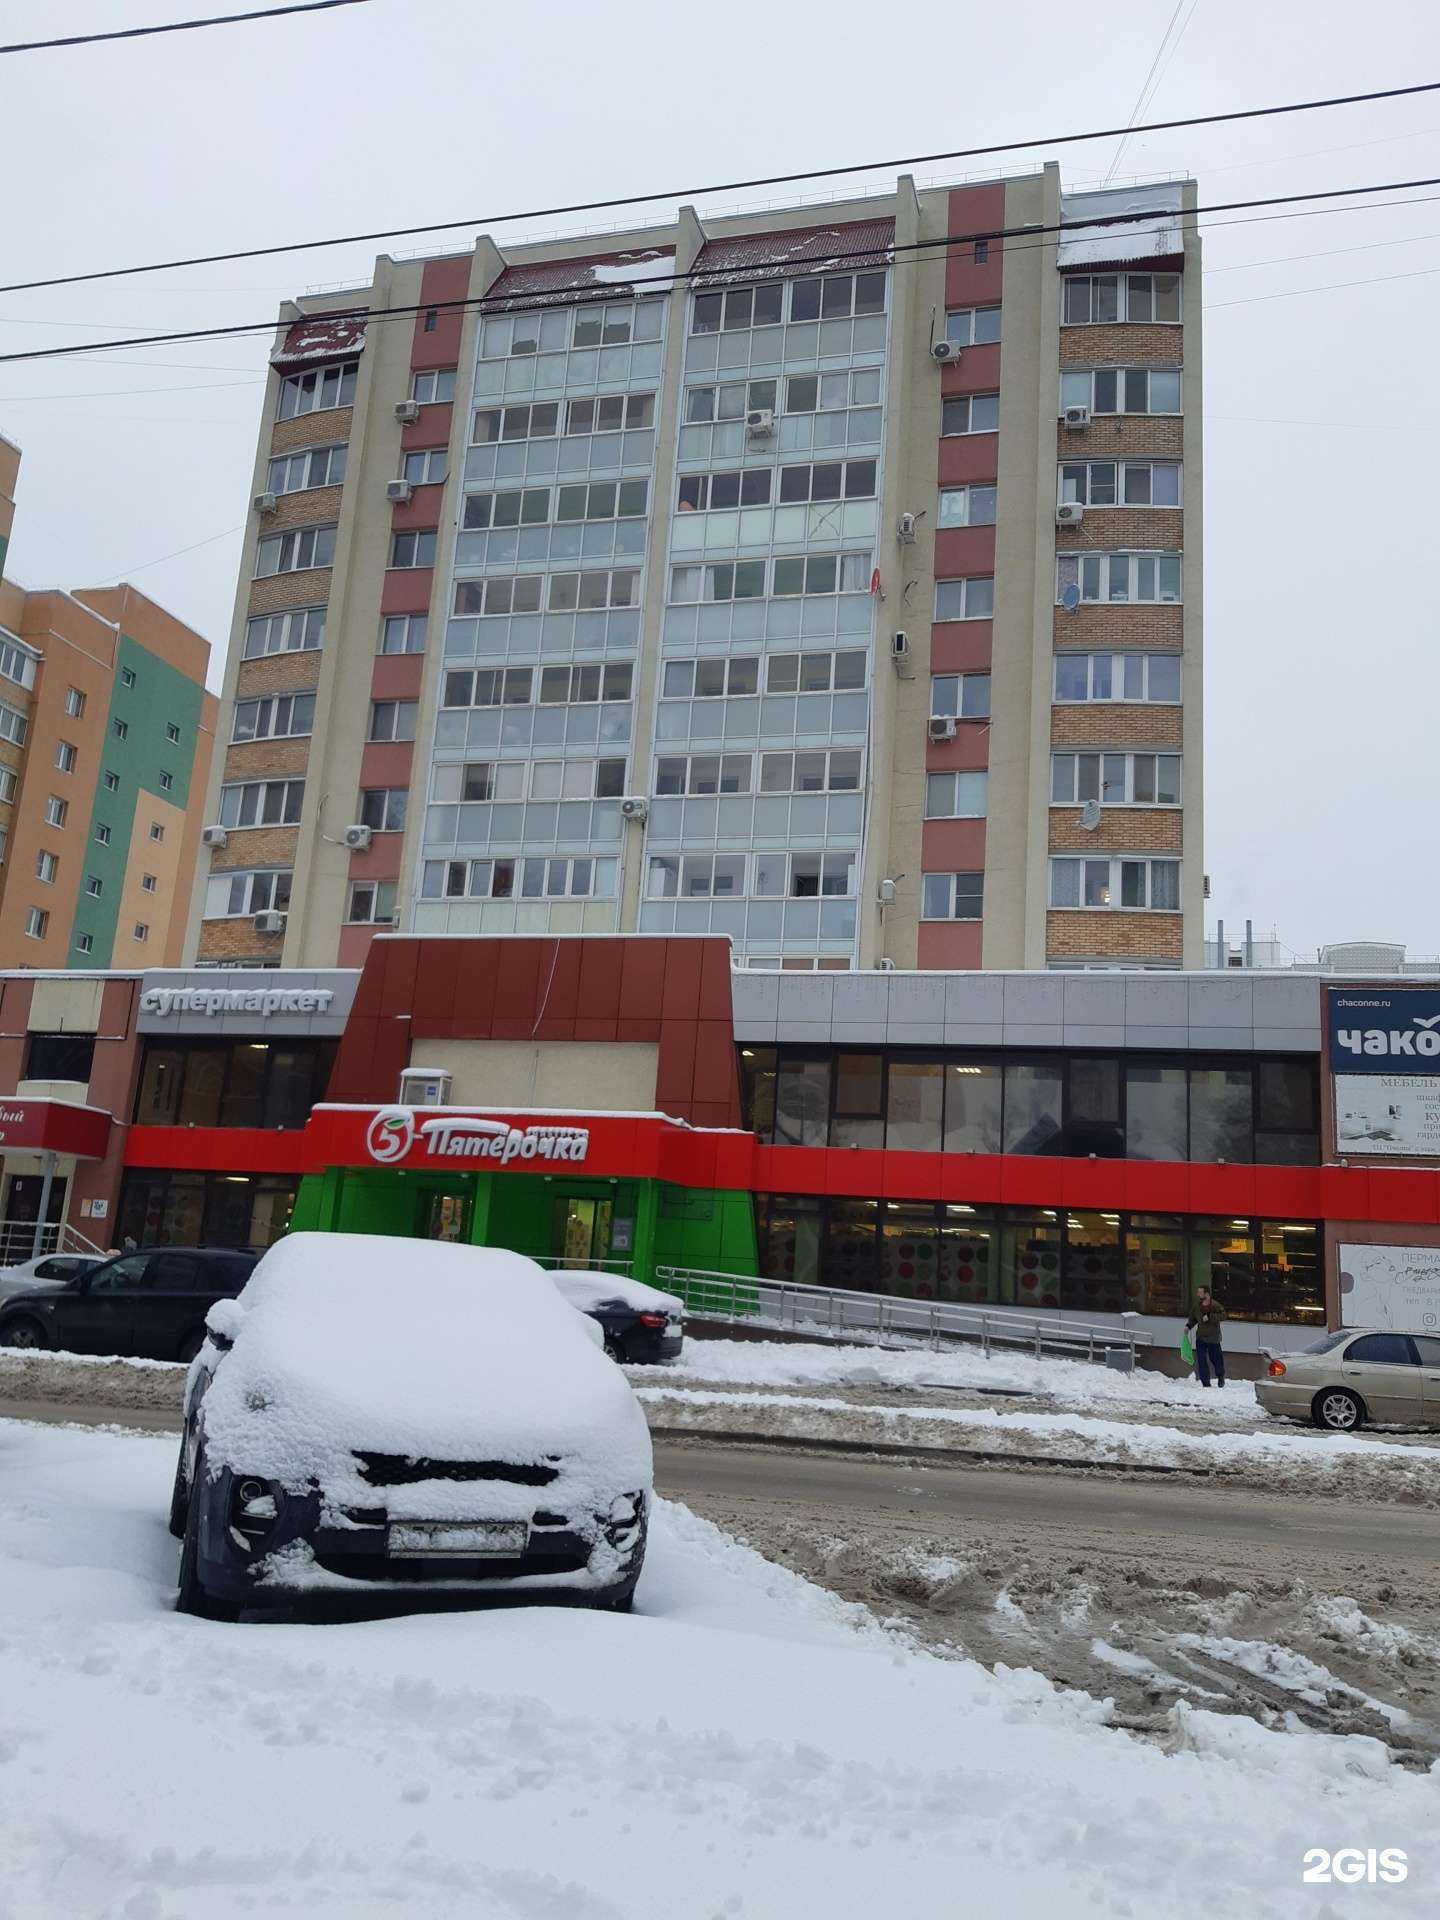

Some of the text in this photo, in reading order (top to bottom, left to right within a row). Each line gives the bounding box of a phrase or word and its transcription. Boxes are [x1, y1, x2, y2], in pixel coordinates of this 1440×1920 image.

[140, 988, 334, 1016] супермаркет
[1337, 999, 1391, 1007] chaconne.ru
[1380, 1078, 1437, 1088] МЕБЕЛЬ
